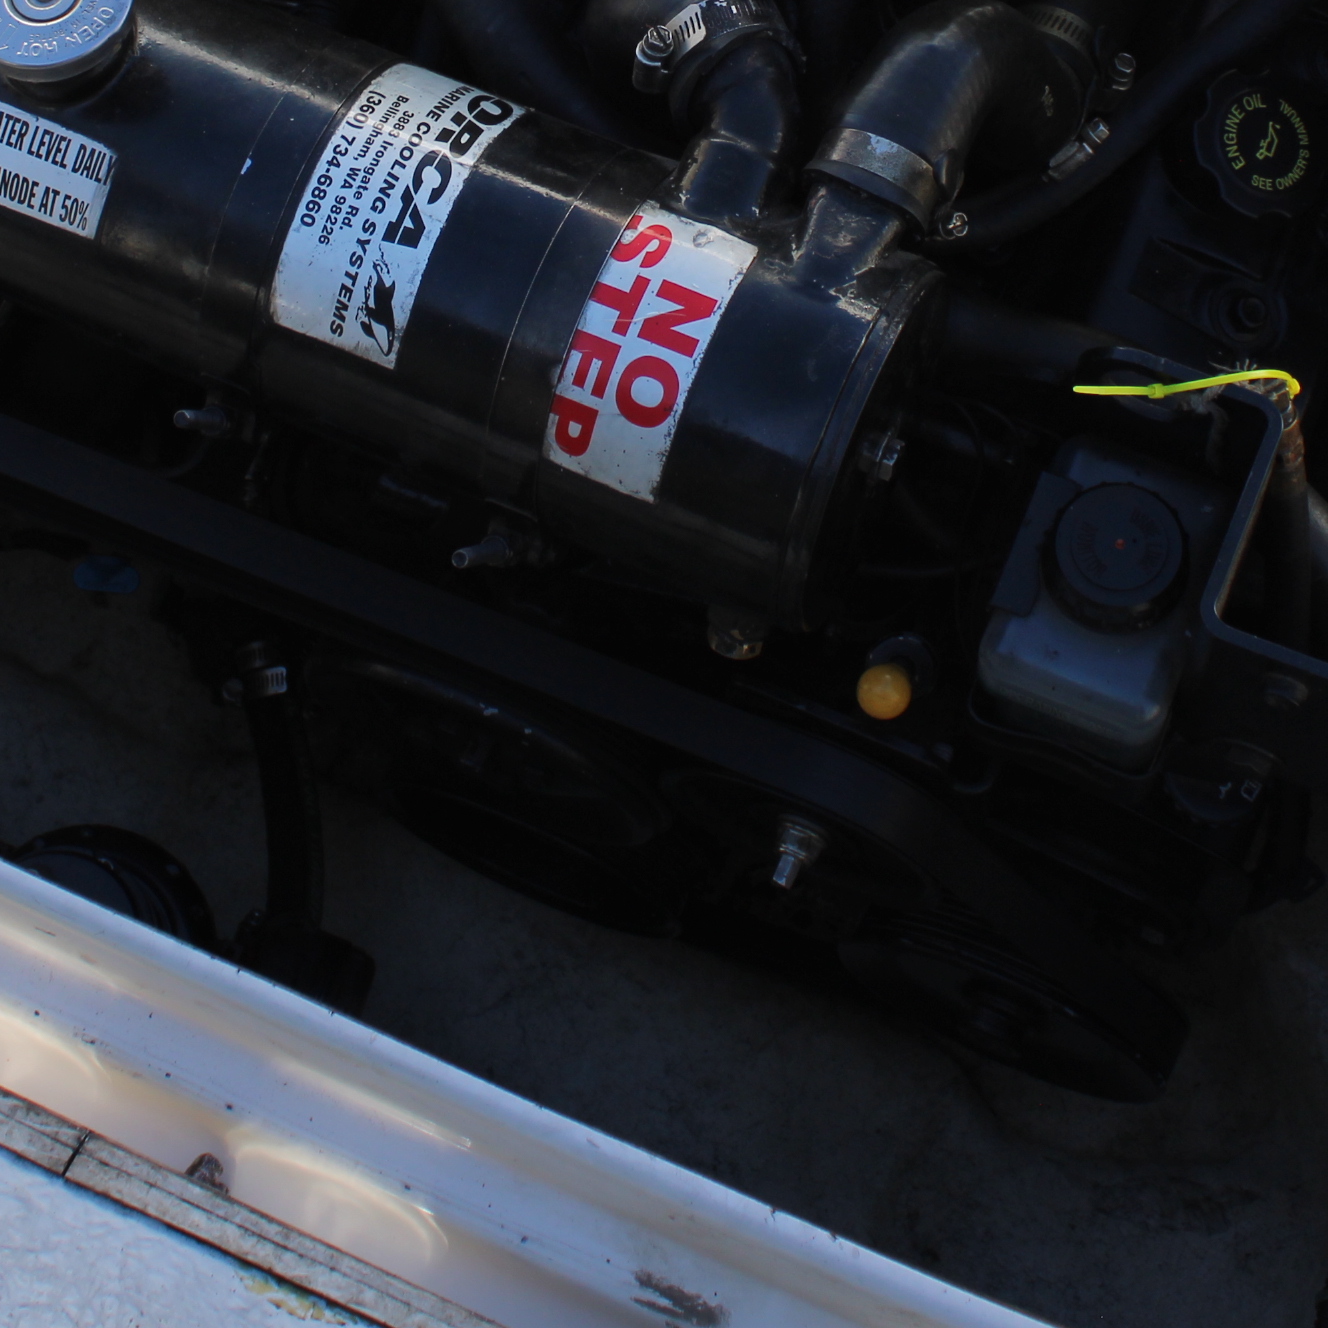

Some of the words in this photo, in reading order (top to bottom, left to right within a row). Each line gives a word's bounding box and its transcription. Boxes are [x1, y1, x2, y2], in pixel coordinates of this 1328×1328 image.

[15, 41, 59, 57] HOT
[66, 6, 115, 45] OPEN
[352, 90, 387, 130] (360)
[353, 94, 410, 162] Bellingham,
[388, 110, 415, 140] 3883
[425, 85, 475, 123] MARINE
[1277, 98, 1311, 147] MANUAL
[26, 125, 72, 170] LEVEL
[71, 143, 119, 187] DAILY
[1223, 103, 1247, 171] ENGINE
[1242, 92, 1268, 111] OIL
[300, 133, 357, 228] 734-6860
[340, 164, 362, 191] WA
[355, 140, 394, 201] Irongate
[369, 121, 432, 216] COOLING
[381, 94, 515, 250] ORCA
[1250, 173, 1274, 192] SEE
[1275, 148, 1311, 191] OWNER'S
[38, 185, 61, 218] AT
[59, 194, 90, 232] 50%
[318, 194, 347, 246] 98226
[338, 204, 360, 231] Rd.
[329, 217, 378, 338] SYSTEMS
[548, 213, 672, 459] STEP
[614, 280, 720, 430] NO
